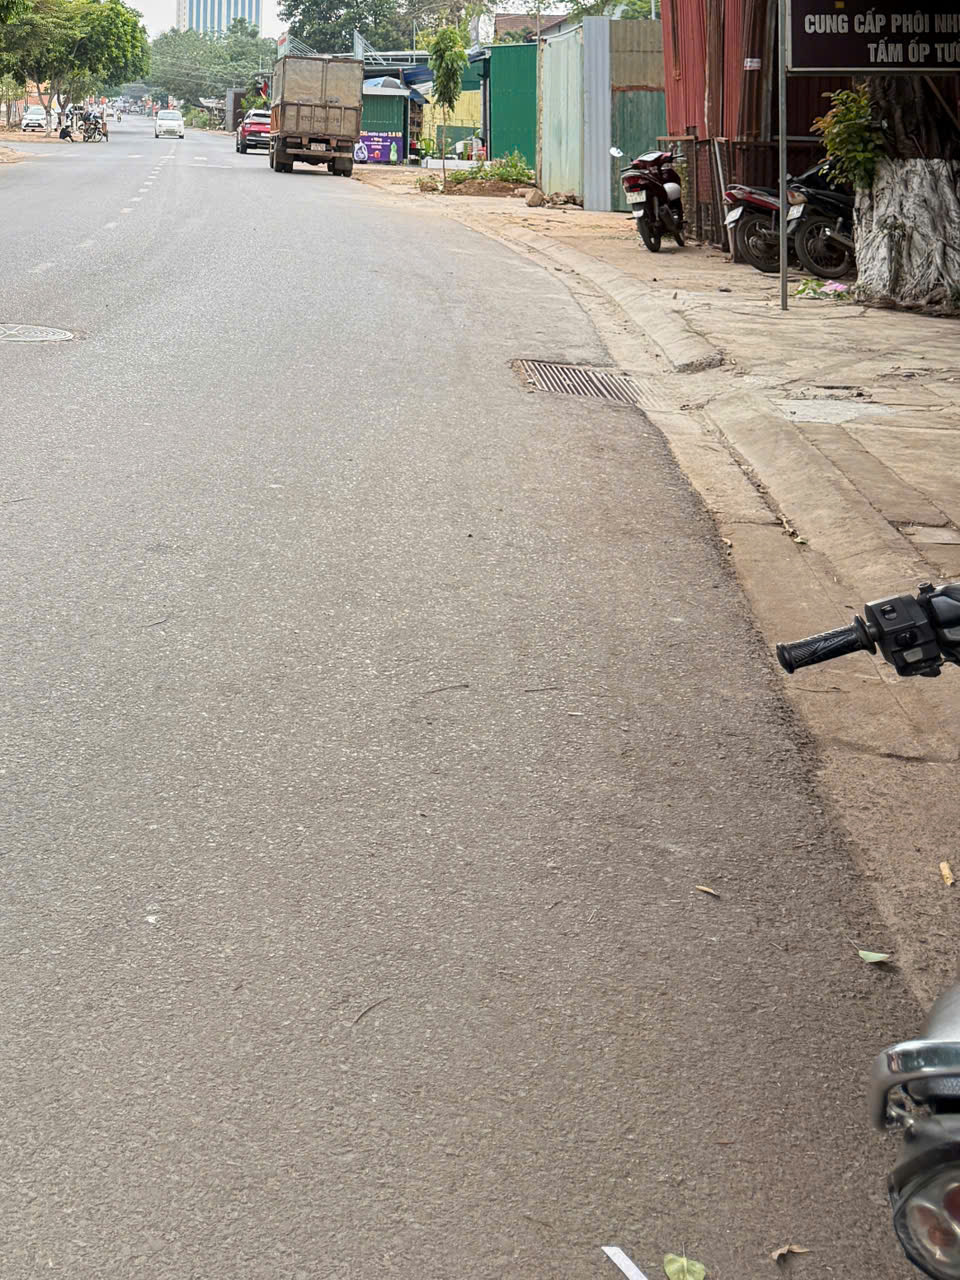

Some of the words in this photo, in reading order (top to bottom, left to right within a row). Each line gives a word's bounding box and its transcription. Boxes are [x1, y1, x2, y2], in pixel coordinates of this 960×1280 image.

[804, 14, 849, 34] CUNG
[854, 7, 886, 34] CẤP
[891, 10, 930, 34] PHÔI
[935, 13, 960, 34] NH
[867, 37, 904, 63] TẤM
[908, 37, 931, 63] ỐP
